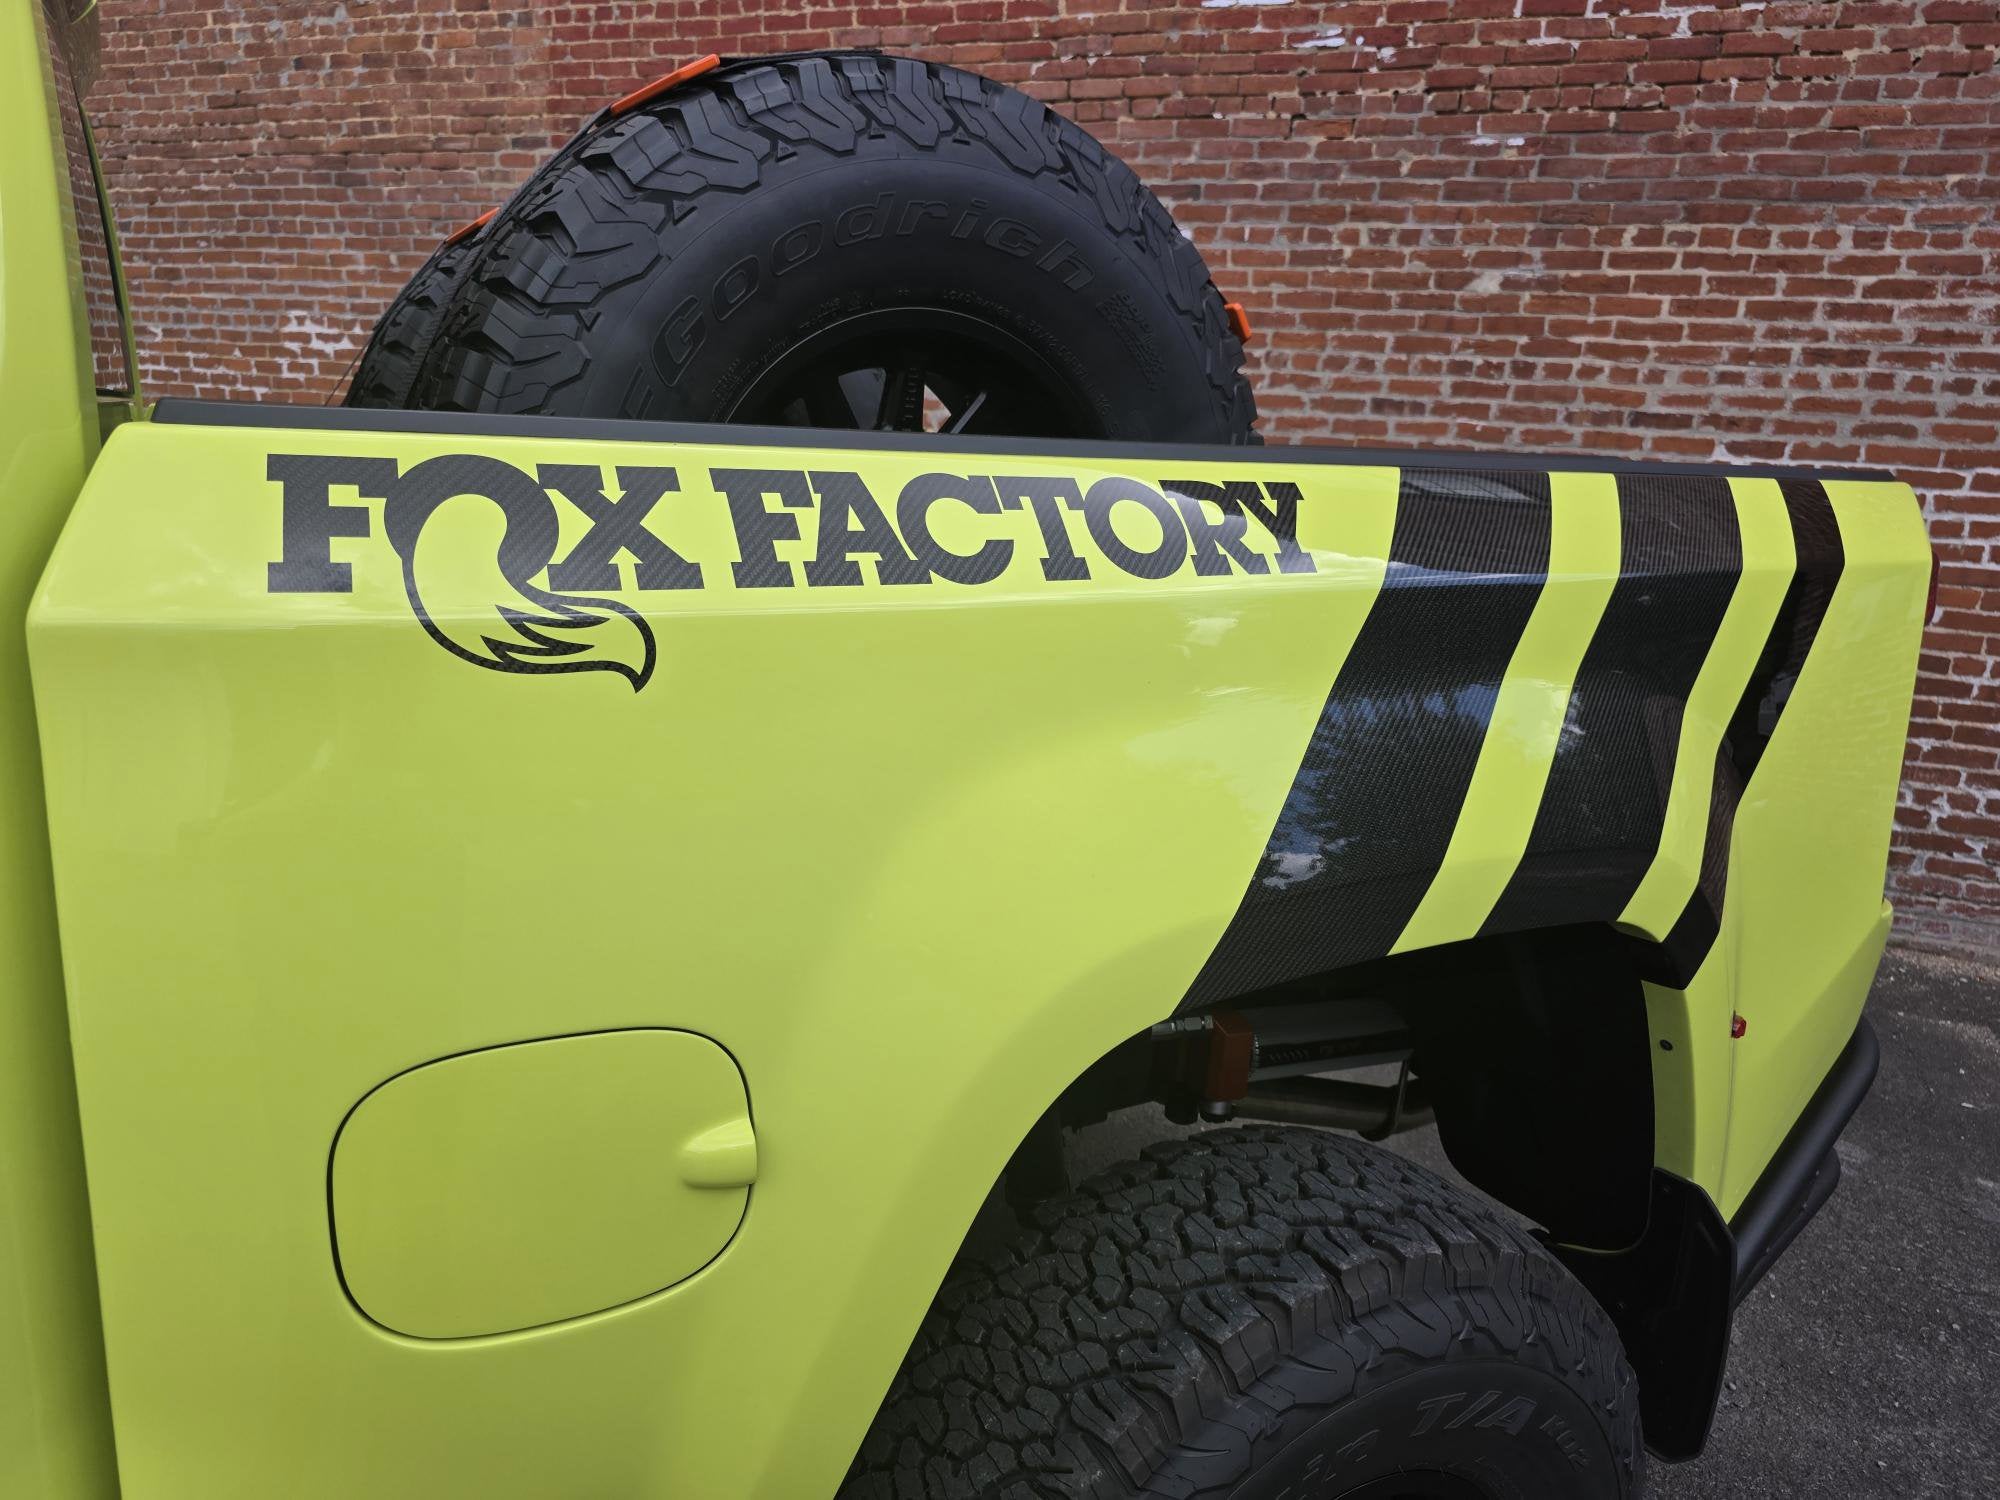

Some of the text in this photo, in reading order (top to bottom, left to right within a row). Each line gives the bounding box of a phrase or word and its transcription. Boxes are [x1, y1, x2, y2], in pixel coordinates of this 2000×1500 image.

[267, 454, 1317, 692] FOX FACTORY
[1409, 1391, 1538, 1437] T/A
